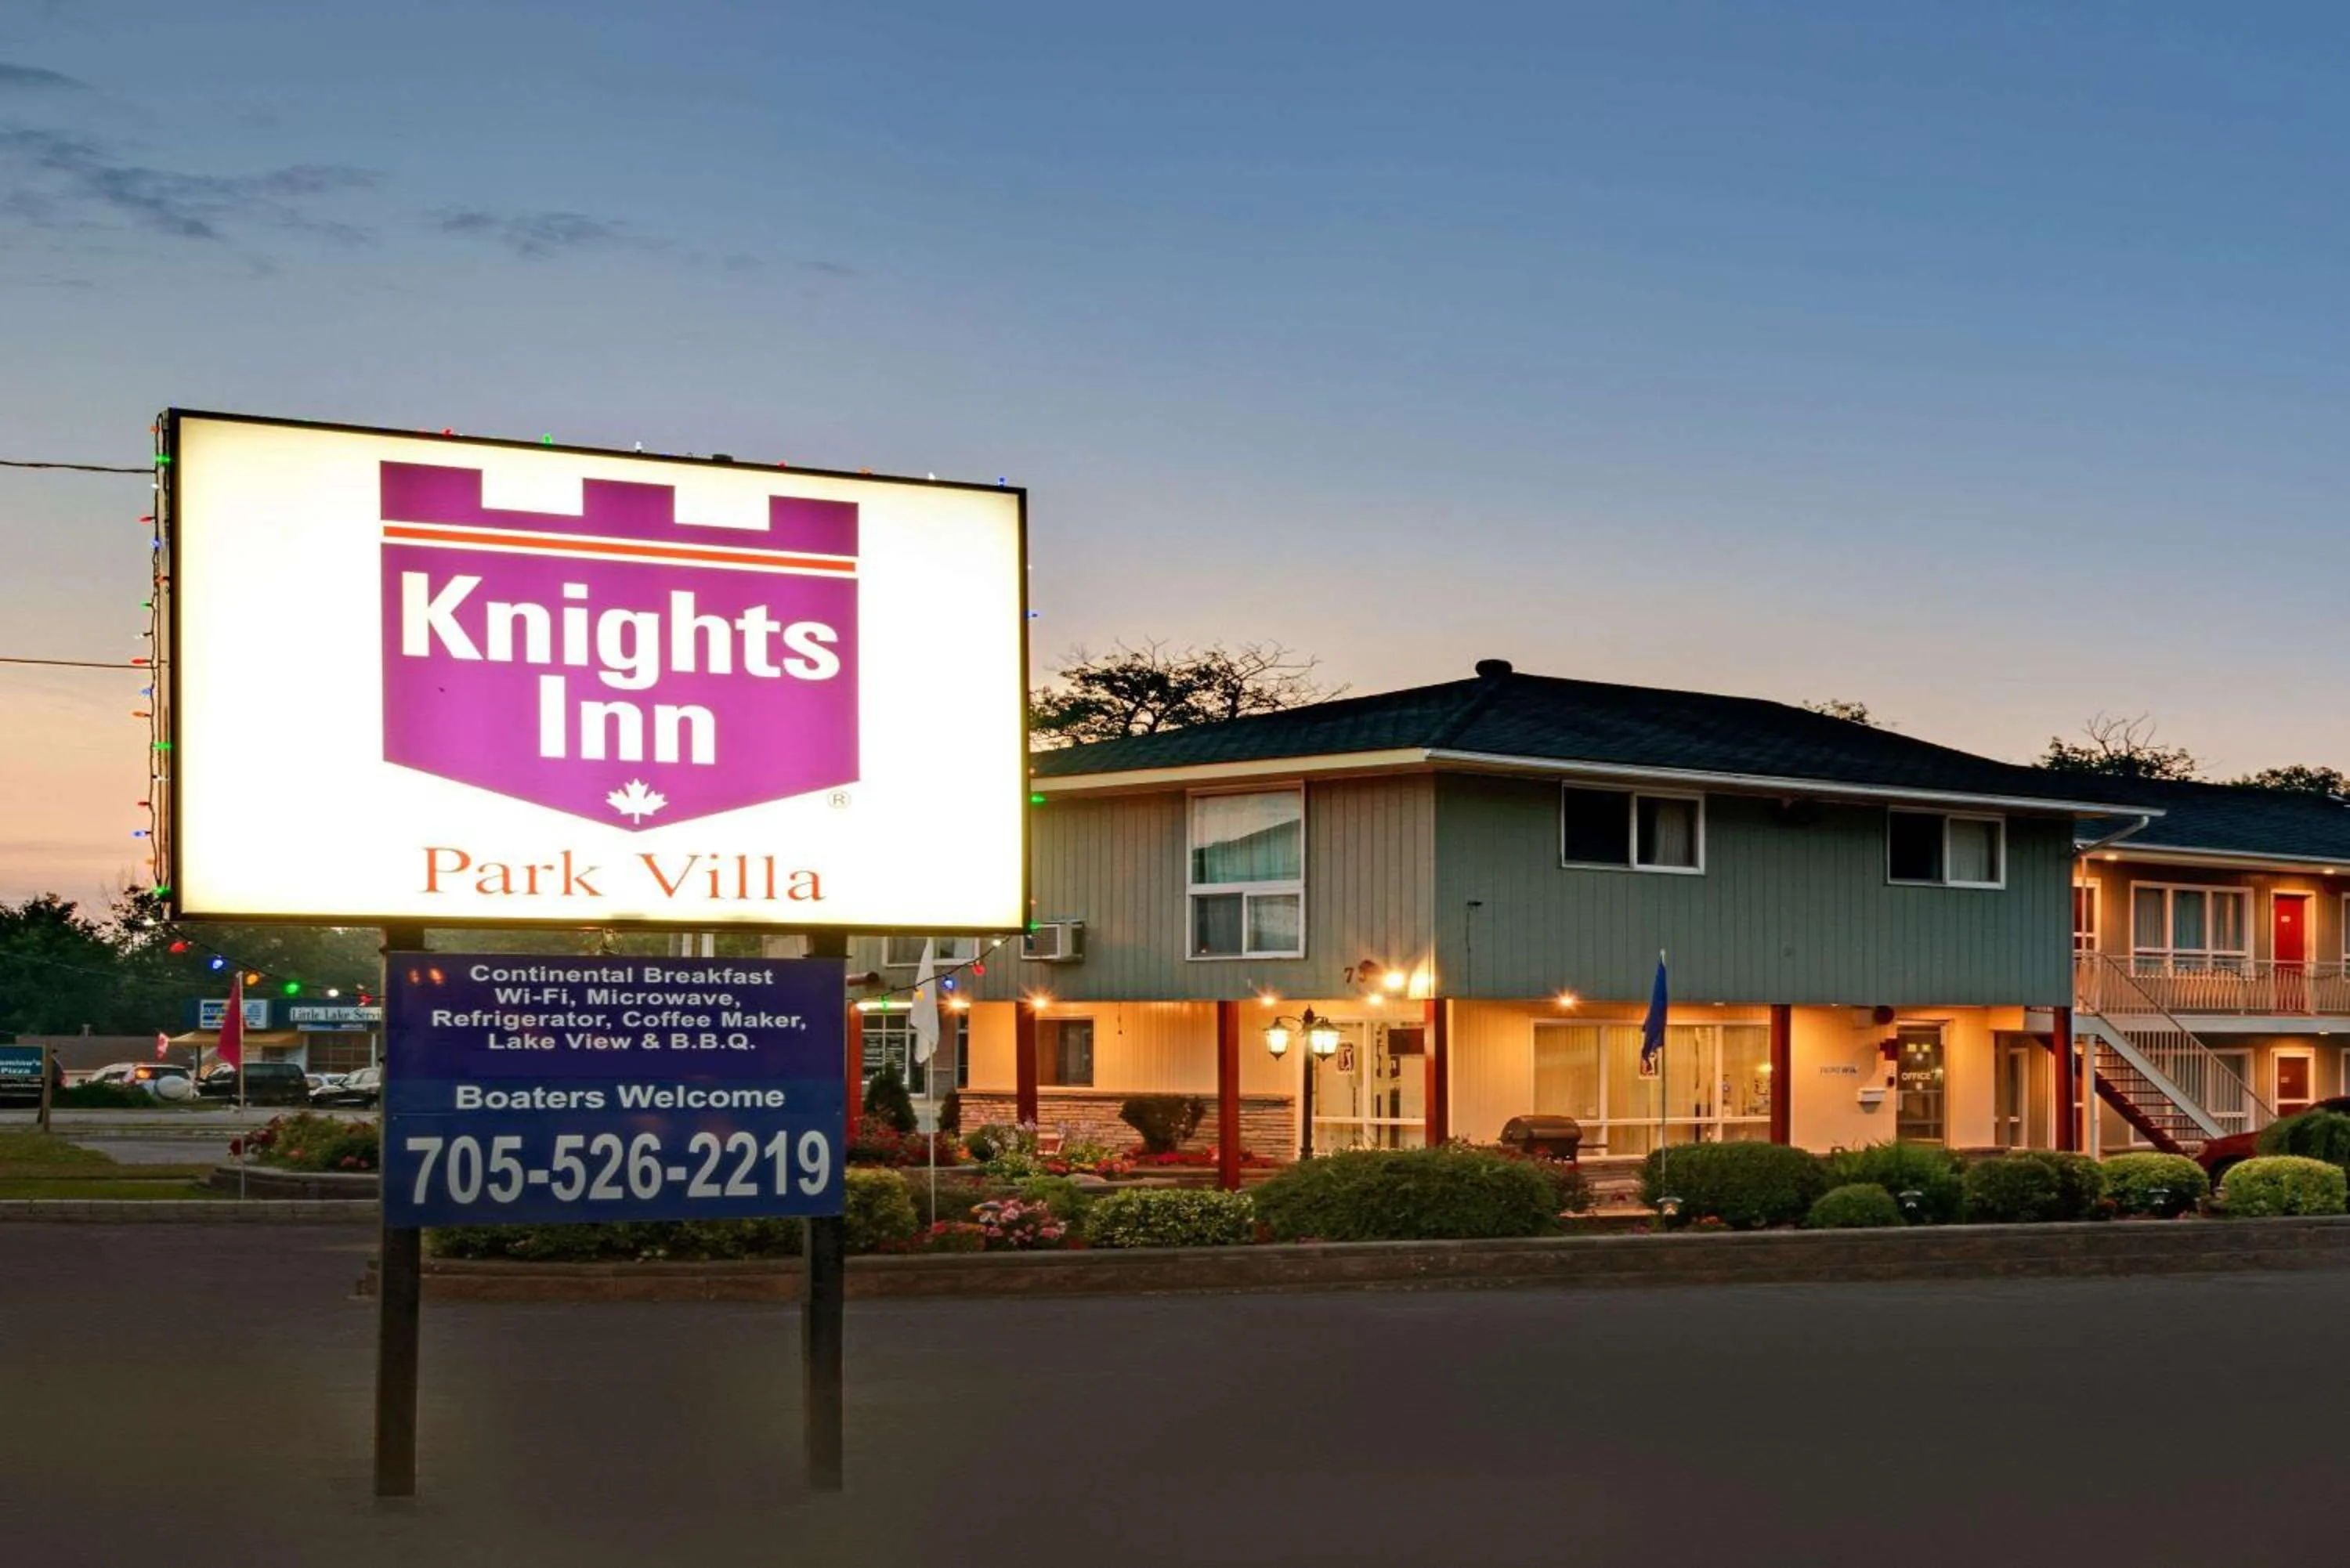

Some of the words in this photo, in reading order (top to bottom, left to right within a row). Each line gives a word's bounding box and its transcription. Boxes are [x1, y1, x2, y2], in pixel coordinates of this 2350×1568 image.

[402, 571, 841, 690] Knights
[539, 674, 715, 765] Inn
[421, 847, 605, 898] Park
[636, 853, 827, 902] Villa
[470, 964, 633, 983] Continental
[644, 966, 773, 985] Breakfast
[494, 988, 577, 1008] Wi-Fi,
[587, 988, 741, 1009] Microwave,
[324, 1009, 350, 1021] Lake
[432, 1010, 613, 1031] Refrigerator,
[622, 1010, 711, 1028] Coffee
[721, 1011, 807, 1031] Maker,
[489, 1033, 555, 1050] Lake
[565, 1033, 631, 1050] View
[641, 1033, 660, 1050] &
[671, 1034, 756, 1051] B.B.Q.
[1901, 1071, 1931, 1081] OFFICE
[456, 1085, 606, 1110] Boaters
[617, 1084, 786, 1109] Welcome
[407, 1130, 830, 1205] 705-526-2219
